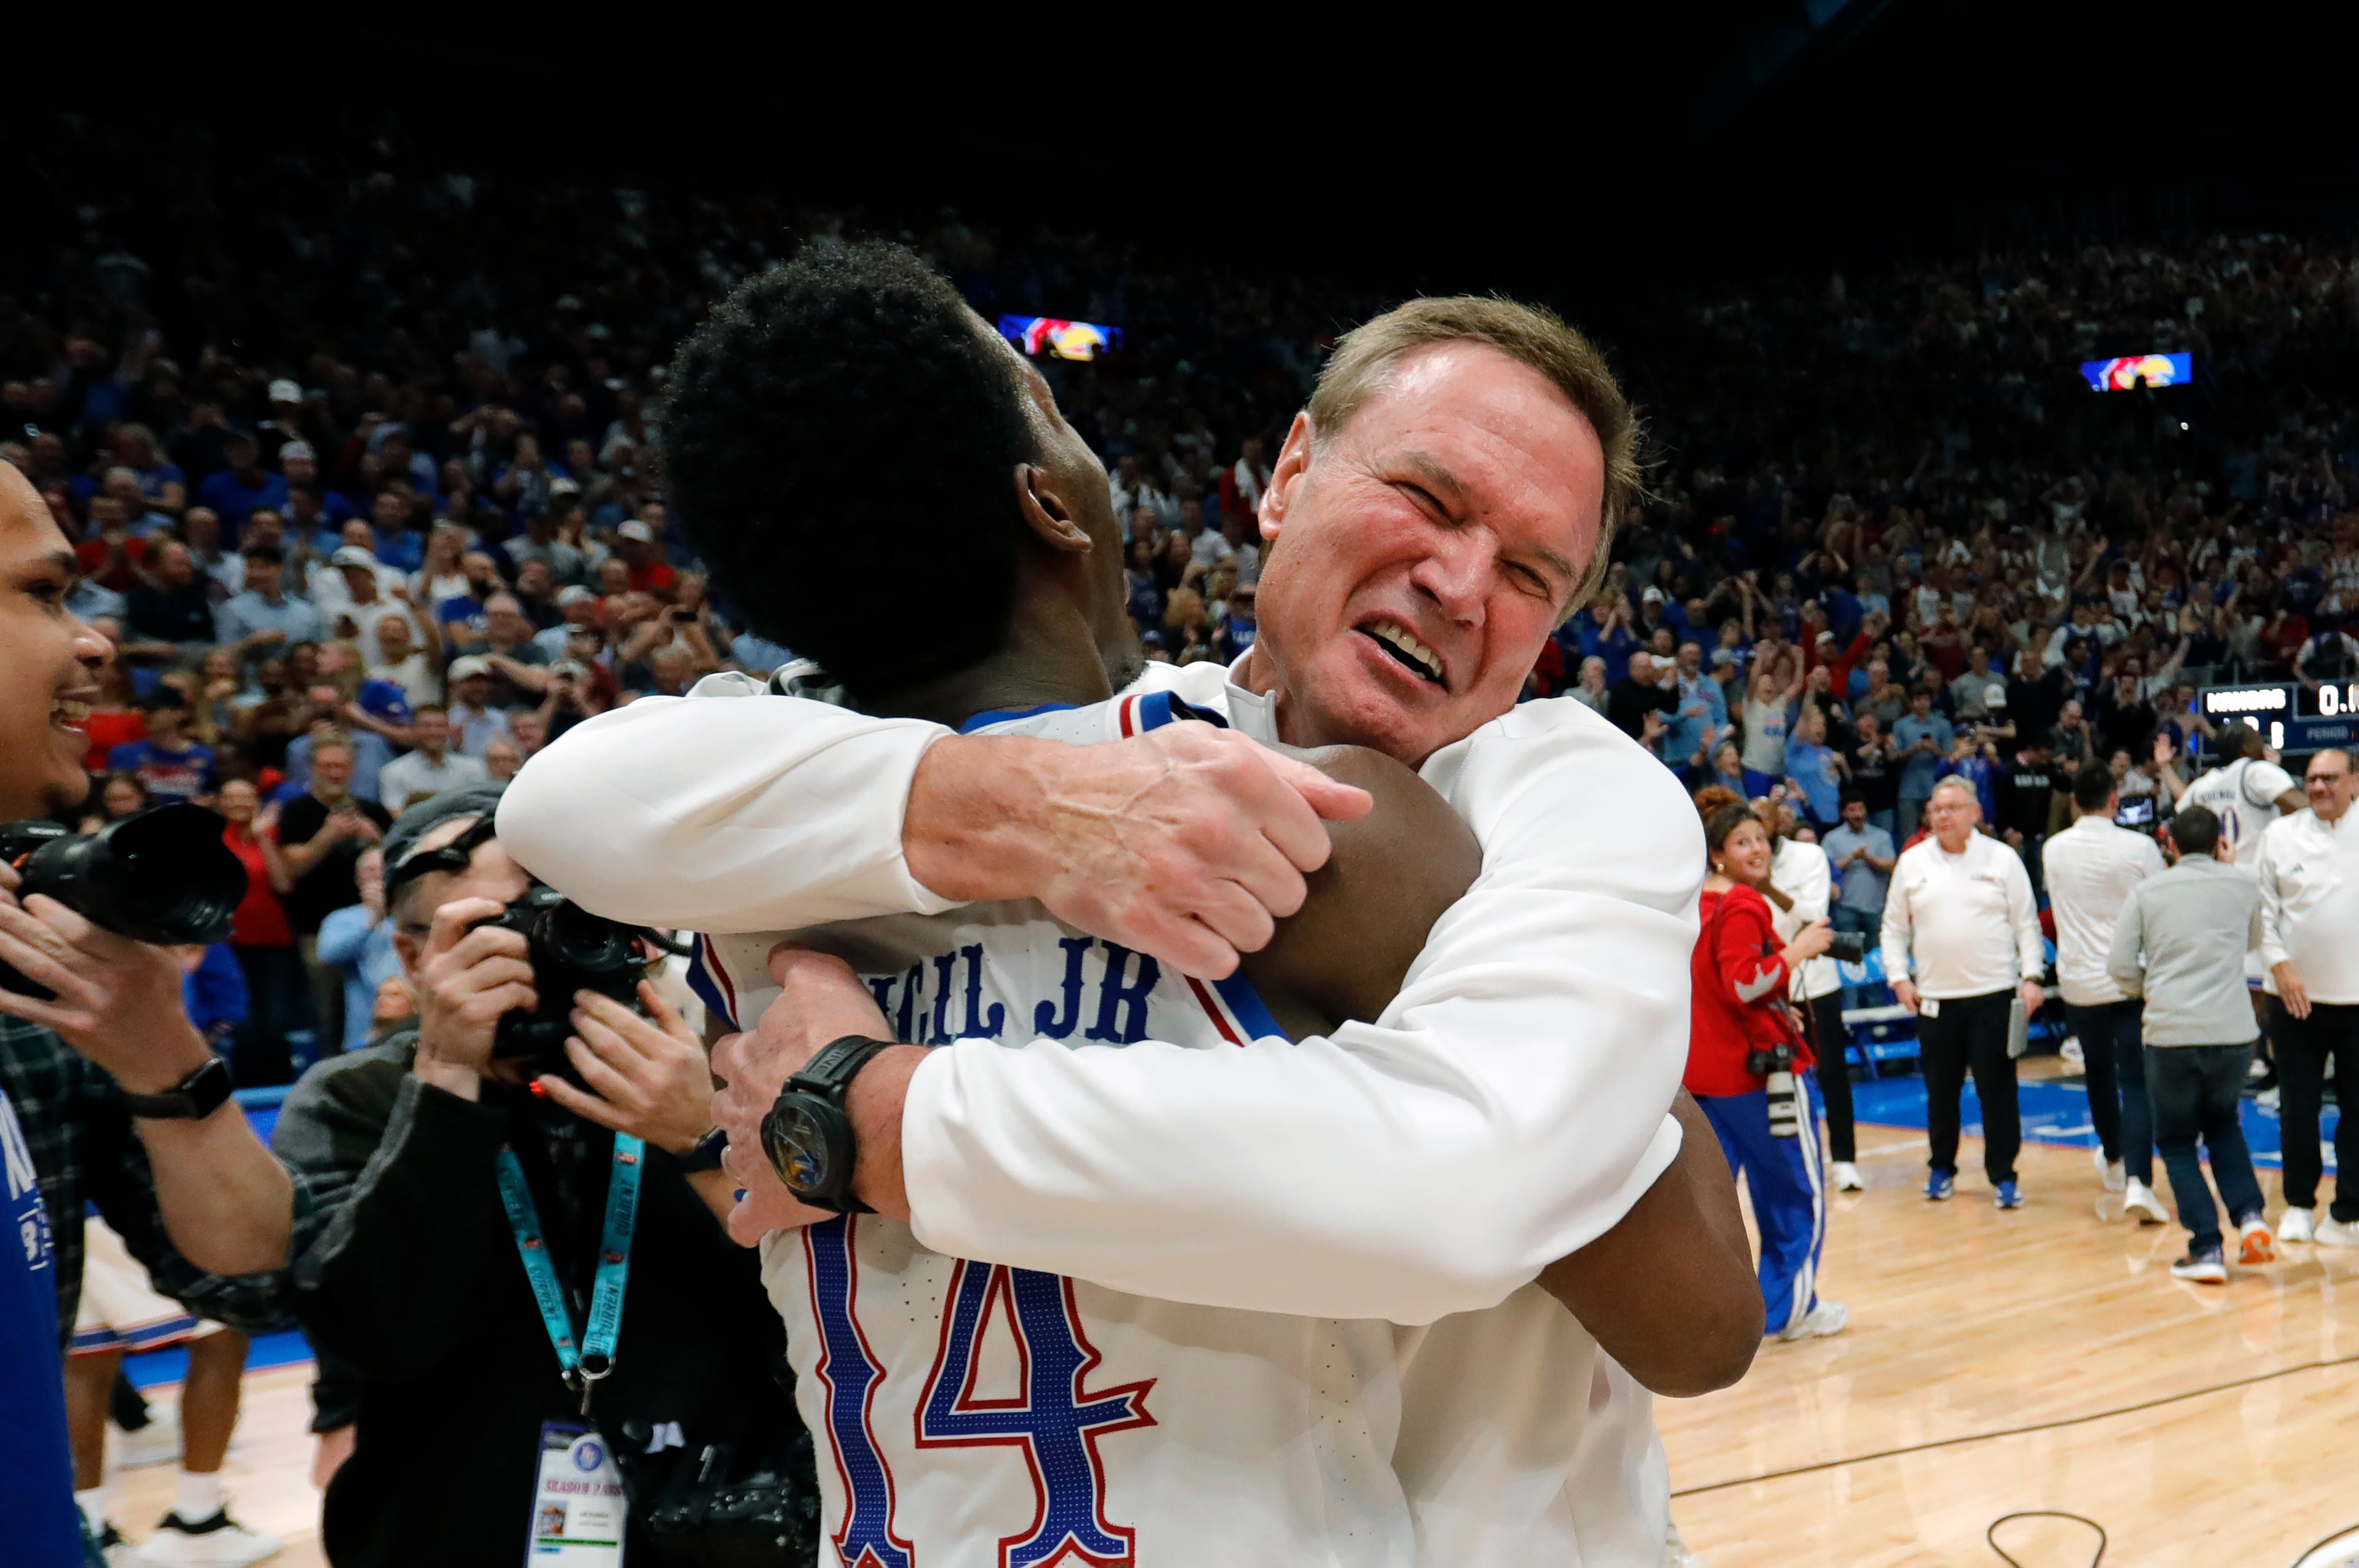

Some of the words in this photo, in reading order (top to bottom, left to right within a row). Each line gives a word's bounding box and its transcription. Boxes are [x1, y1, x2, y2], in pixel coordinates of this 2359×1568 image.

[2318, 684, 2354, 716] 0.
[1033, 936, 1161, 1044] JR
[800, 1211, 1158, 1568] 14
